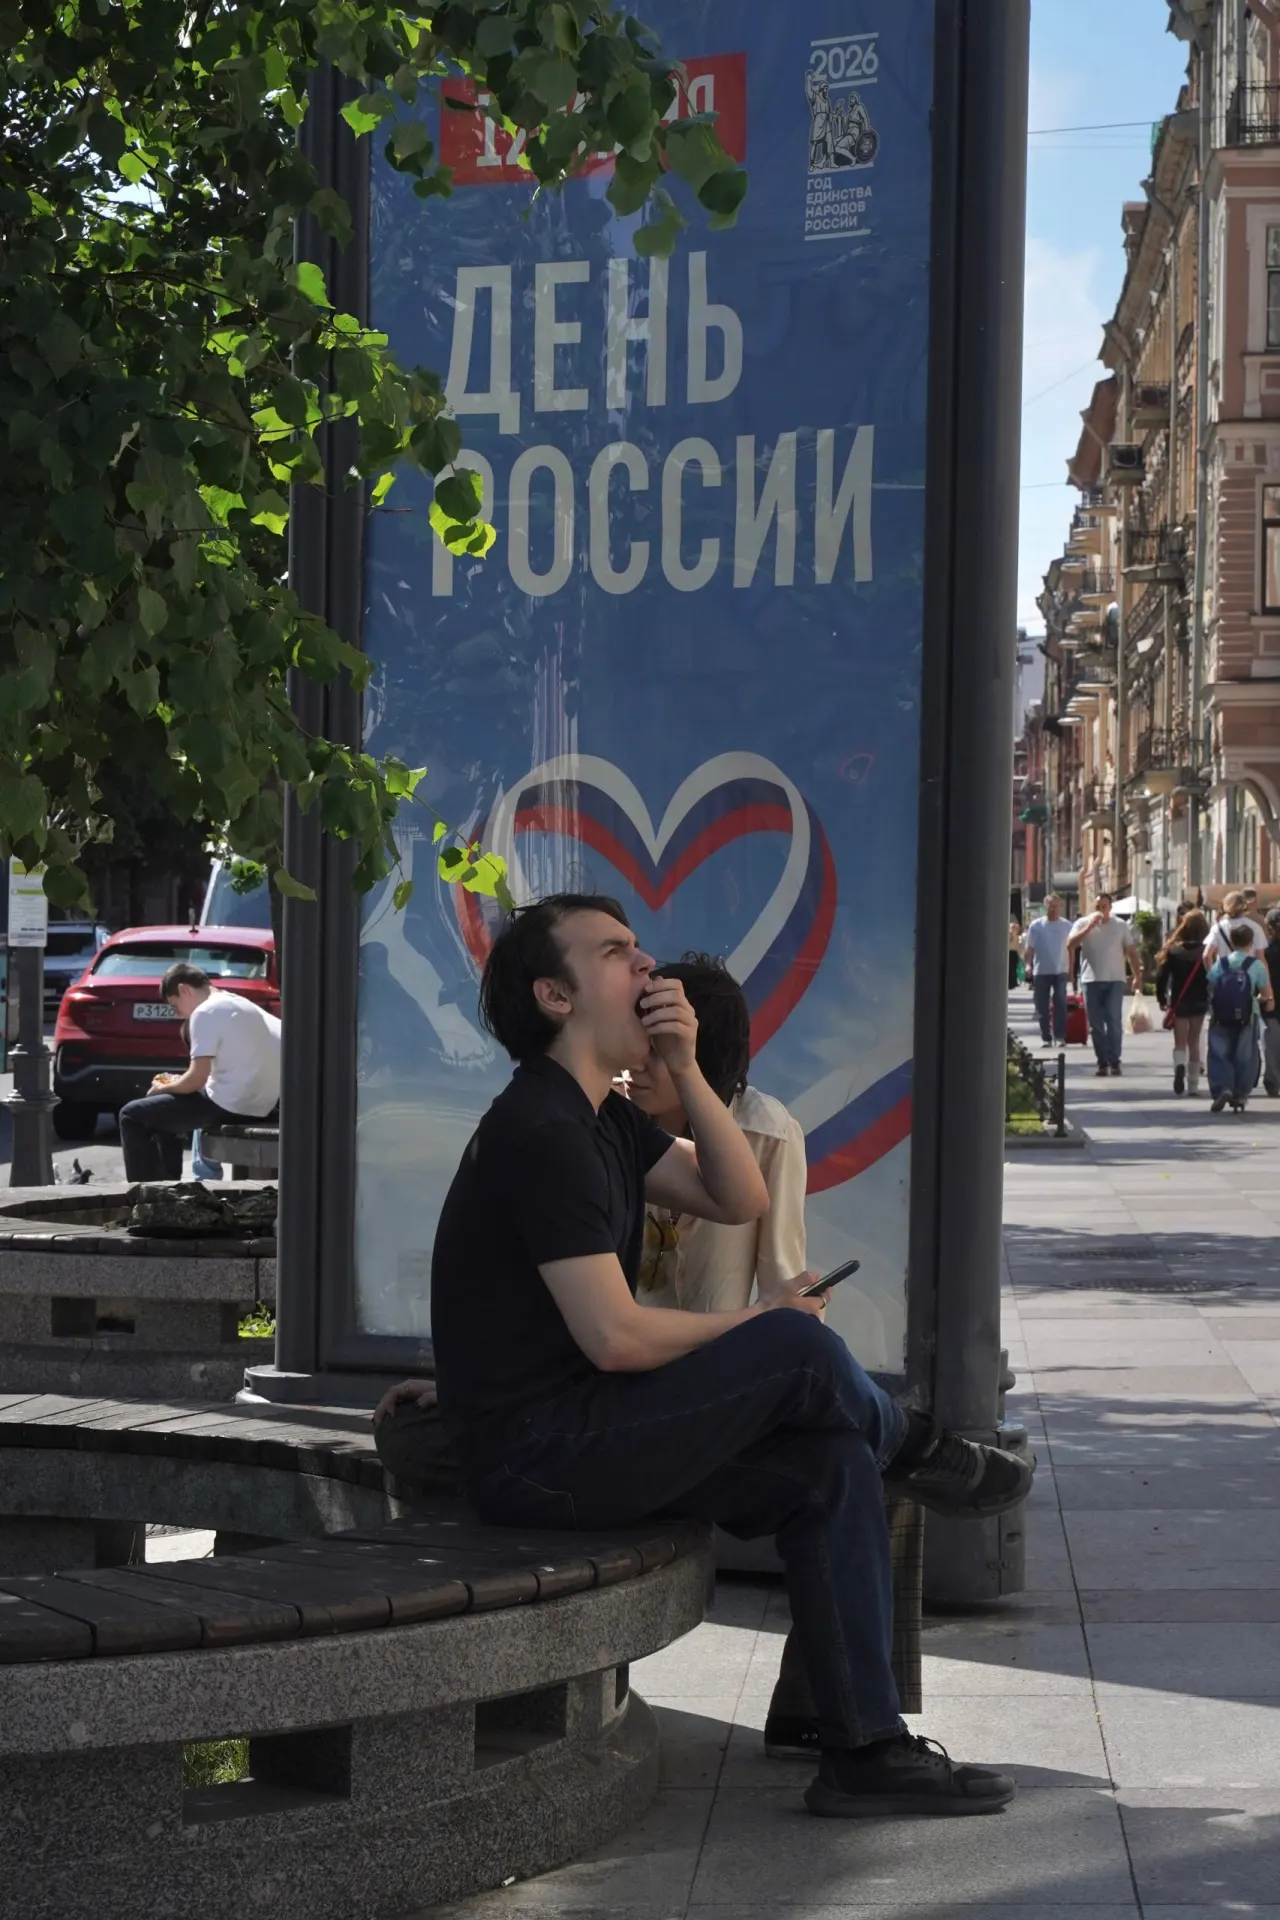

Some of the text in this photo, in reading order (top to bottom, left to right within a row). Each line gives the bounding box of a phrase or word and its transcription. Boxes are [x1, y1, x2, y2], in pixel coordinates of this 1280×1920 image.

[809, 42, 879, 80] 2026
[807, 177, 832, 191] ГОД
[806, 186, 873, 206] ЕДИНСТВА
[805, 201, 866, 218] НАРОДОВ
[805, 215, 857, 232] РОССИИ
[438, 250, 743, 435] ДЕНЬ
